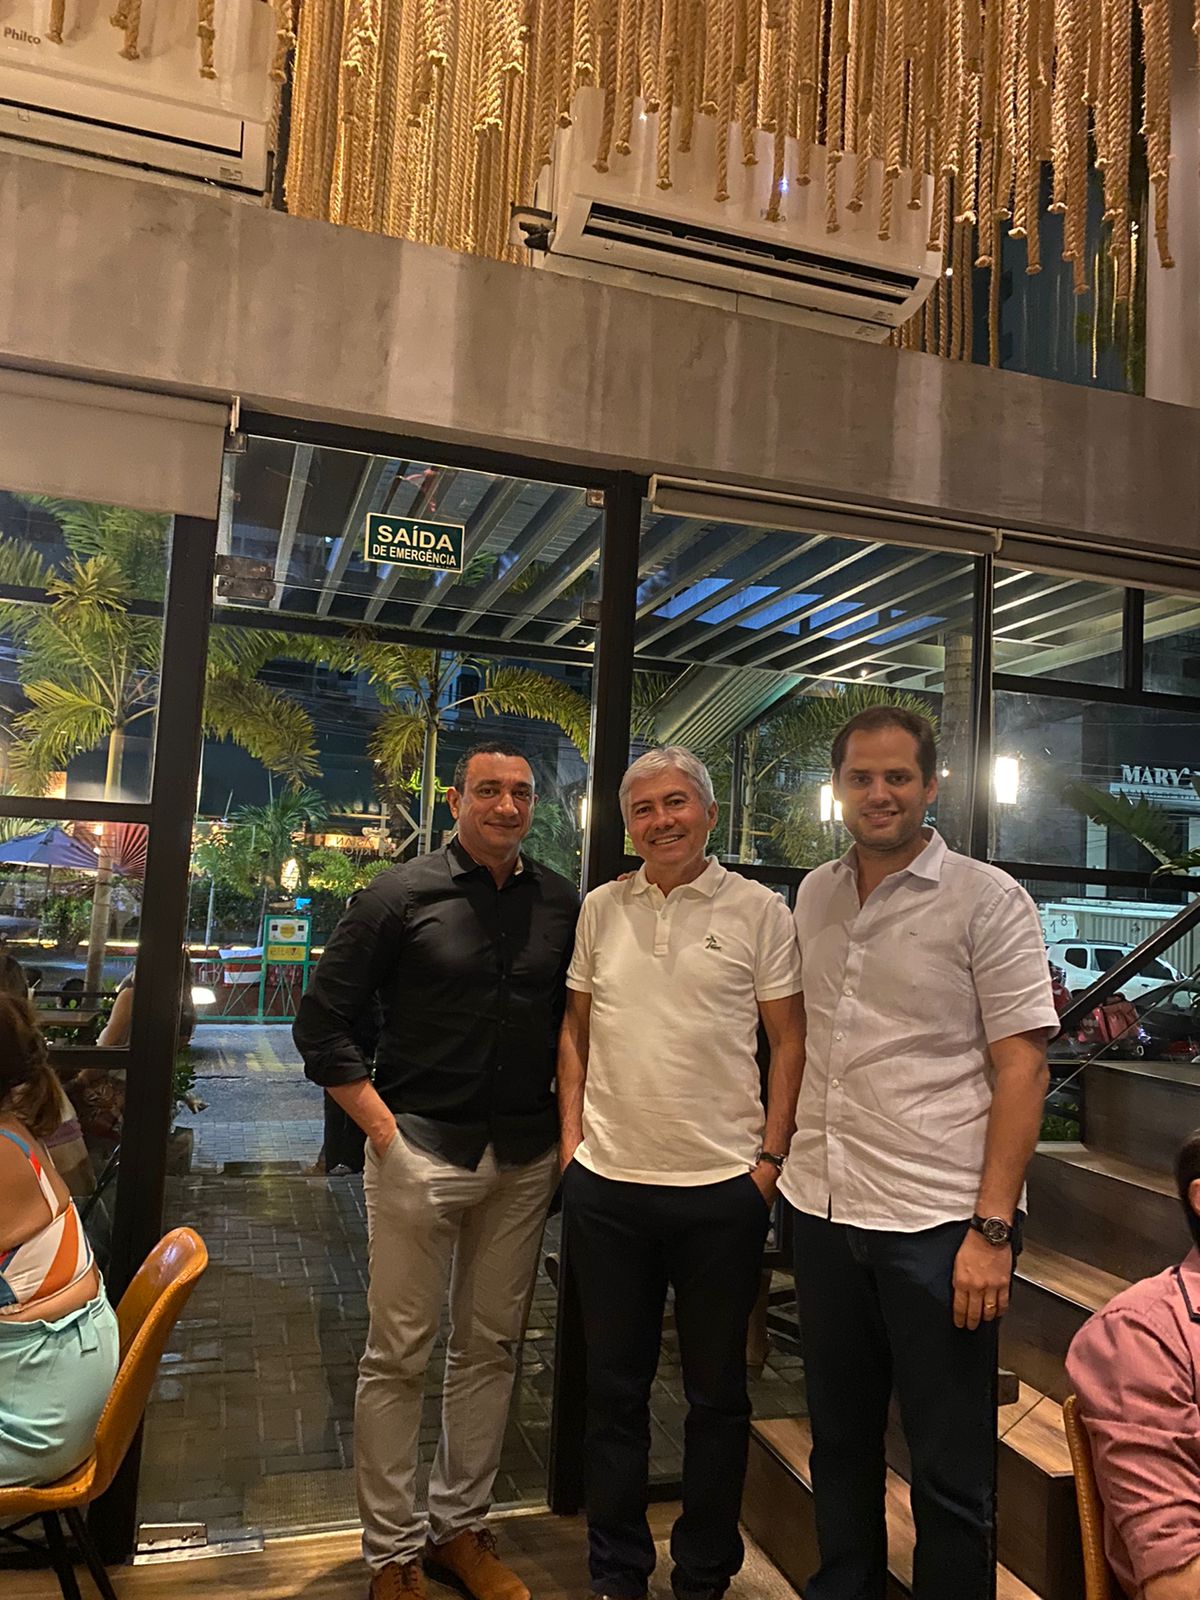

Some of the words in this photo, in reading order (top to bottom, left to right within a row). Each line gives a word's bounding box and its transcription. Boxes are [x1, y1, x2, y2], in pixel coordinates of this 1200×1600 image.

[4, 26, 41, 45] Philco
[377, 525, 454, 552] SAÍDA
[373, 544, 387, 556] DE
[389, 546, 457, 566] EMERGÊNCIA
[1120, 764, 1190, 787] MARY
